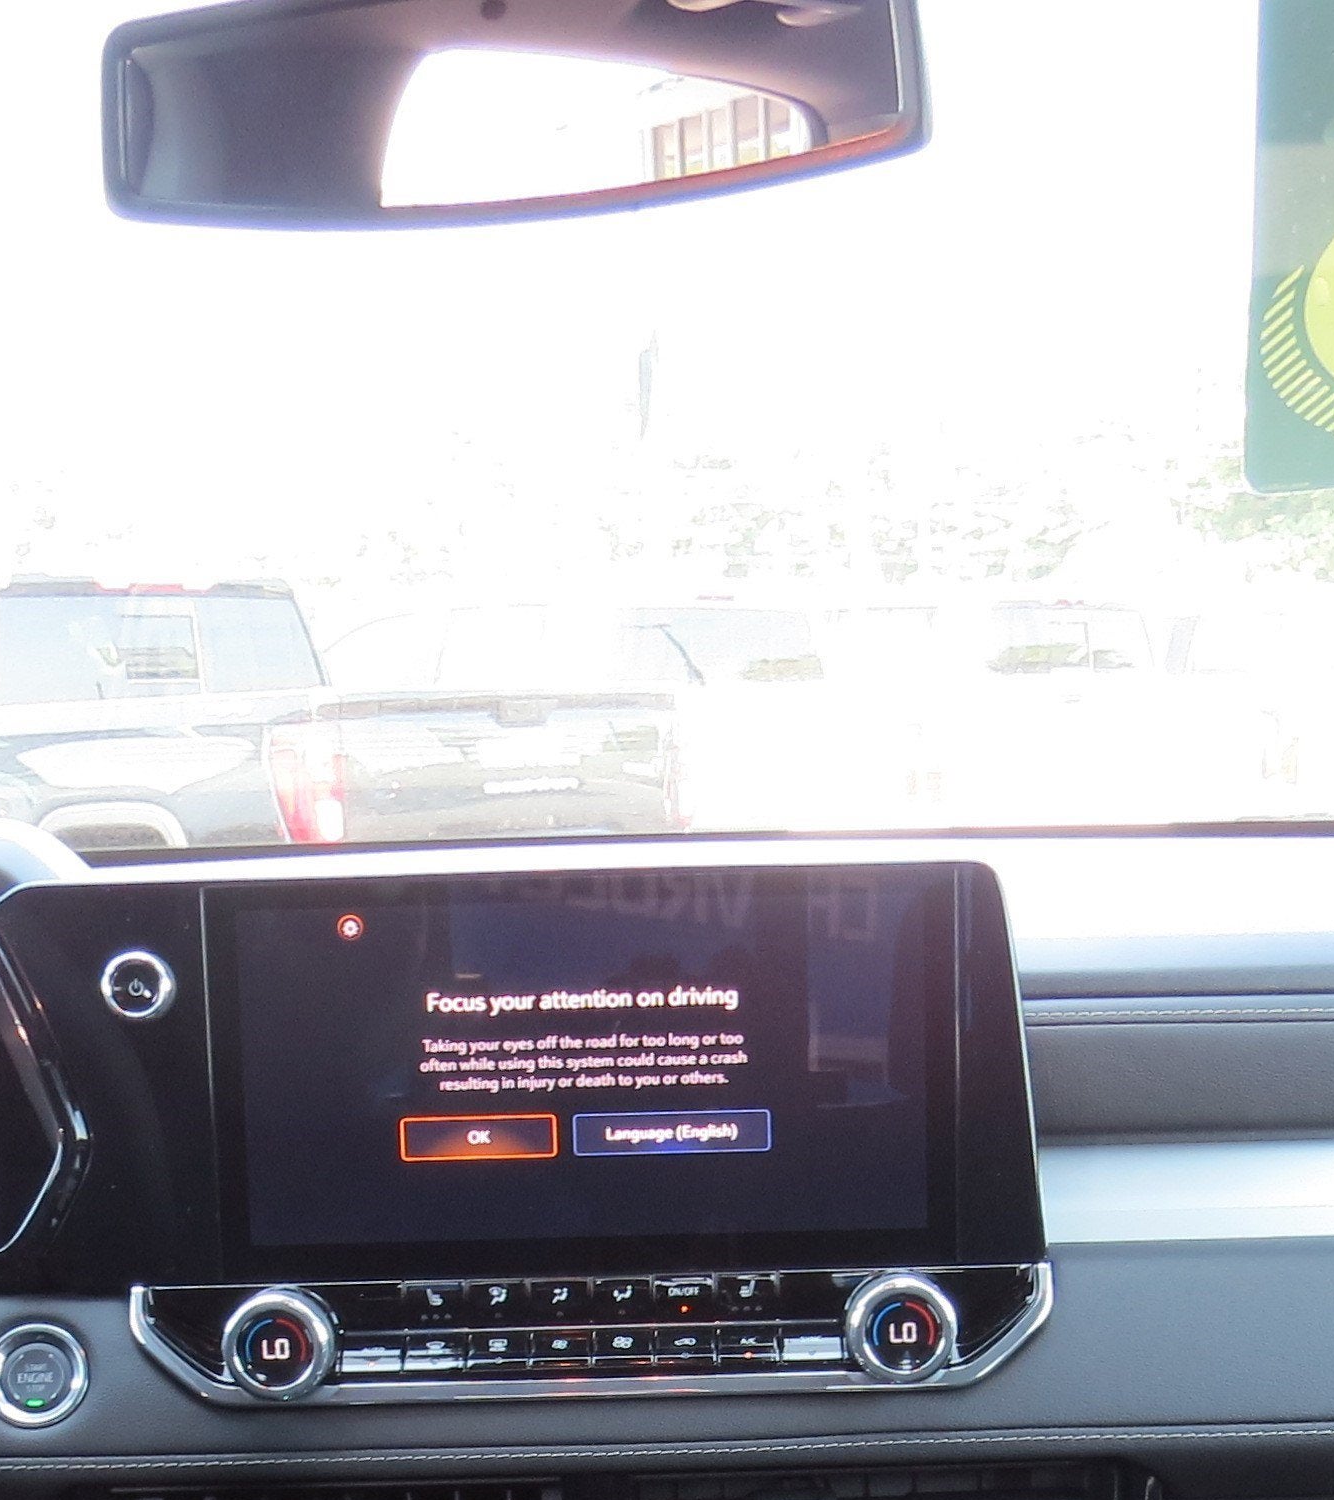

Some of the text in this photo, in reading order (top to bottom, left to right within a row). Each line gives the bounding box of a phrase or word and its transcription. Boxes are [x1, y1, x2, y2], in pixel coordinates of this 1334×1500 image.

[425, 985, 739, 1017] Focus your attention on driving
[421, 1032, 744, 1055] Taking your eyes off the road for too long or too
[419, 1050, 749, 1073] often while using this system could cause a crash
[439, 1069, 729, 1093] resulting in injury or death to you or others.
[467, 1129, 491, 1145] OK
[605, 1122, 739, 1144] Language (English)
[667, 1285, 700, 1297] ON/OFF
[888, 1321, 918, 1344] LO
[260, 1337, 291, 1361] LO
[16, 1371, 54, 1384] ENGINE
